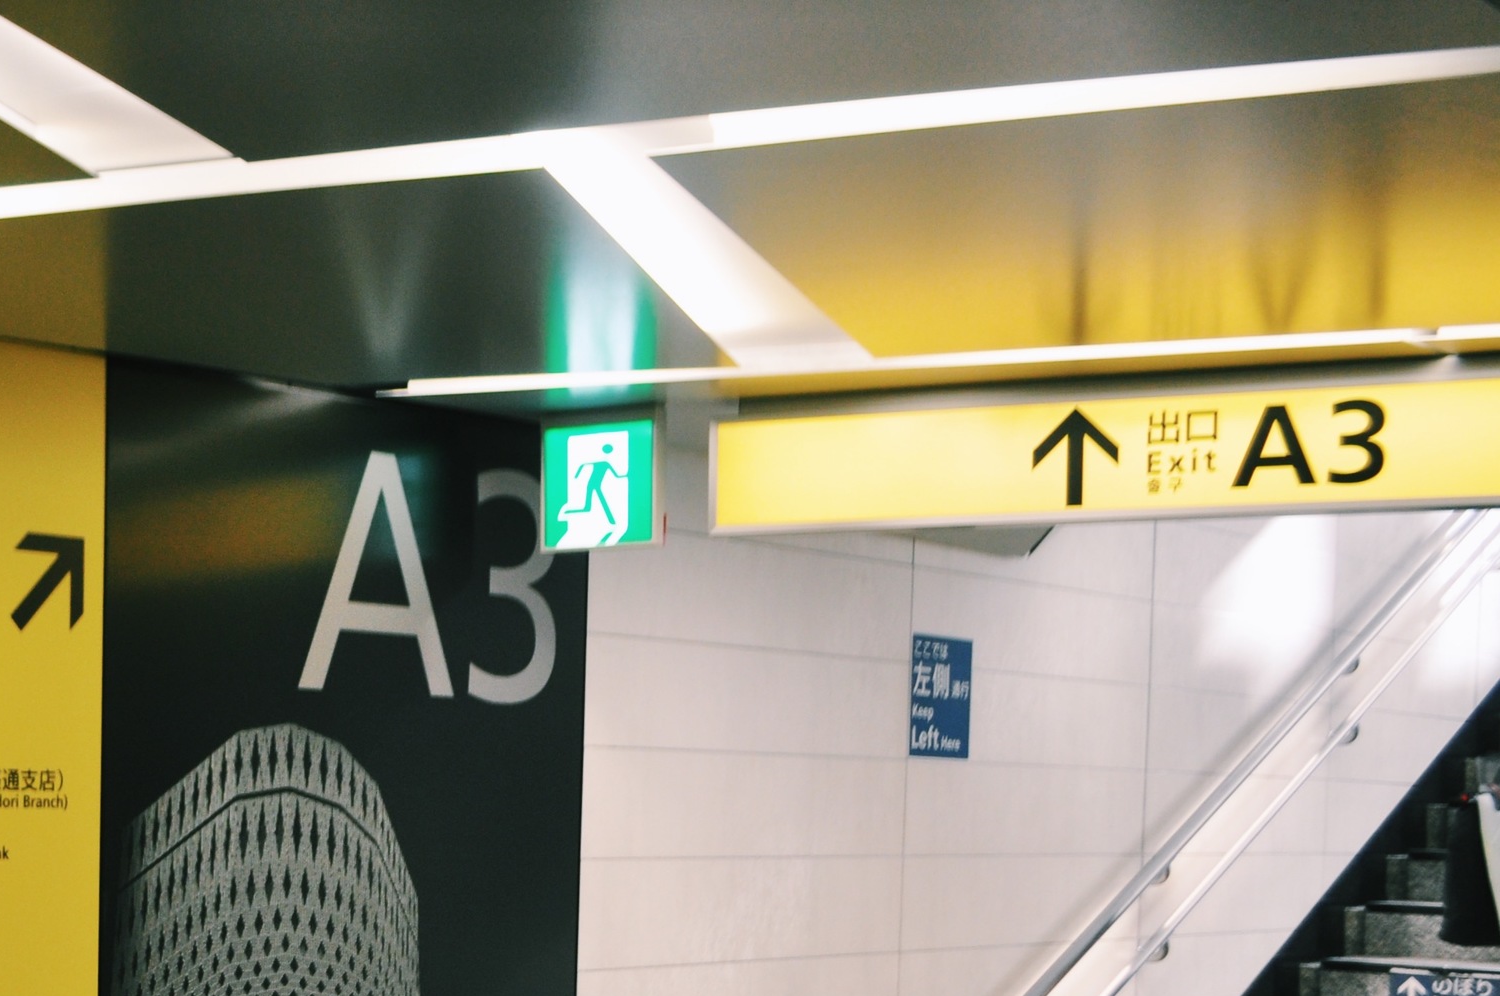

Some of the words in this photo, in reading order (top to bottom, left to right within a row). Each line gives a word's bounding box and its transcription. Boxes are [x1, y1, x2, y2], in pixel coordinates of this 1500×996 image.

[1147, 410, 1218, 445] 出口
[1231, 399, 1387, 487] A3
[1147, 447, 1217, 474] Exit
[298, 450, 556, 705] A3
[912, 702, 934, 722] Keep
[911, 724, 939, 751] Left
[941, 735, 961, 752] Here
[23, 794, 68, 811] Branch)
